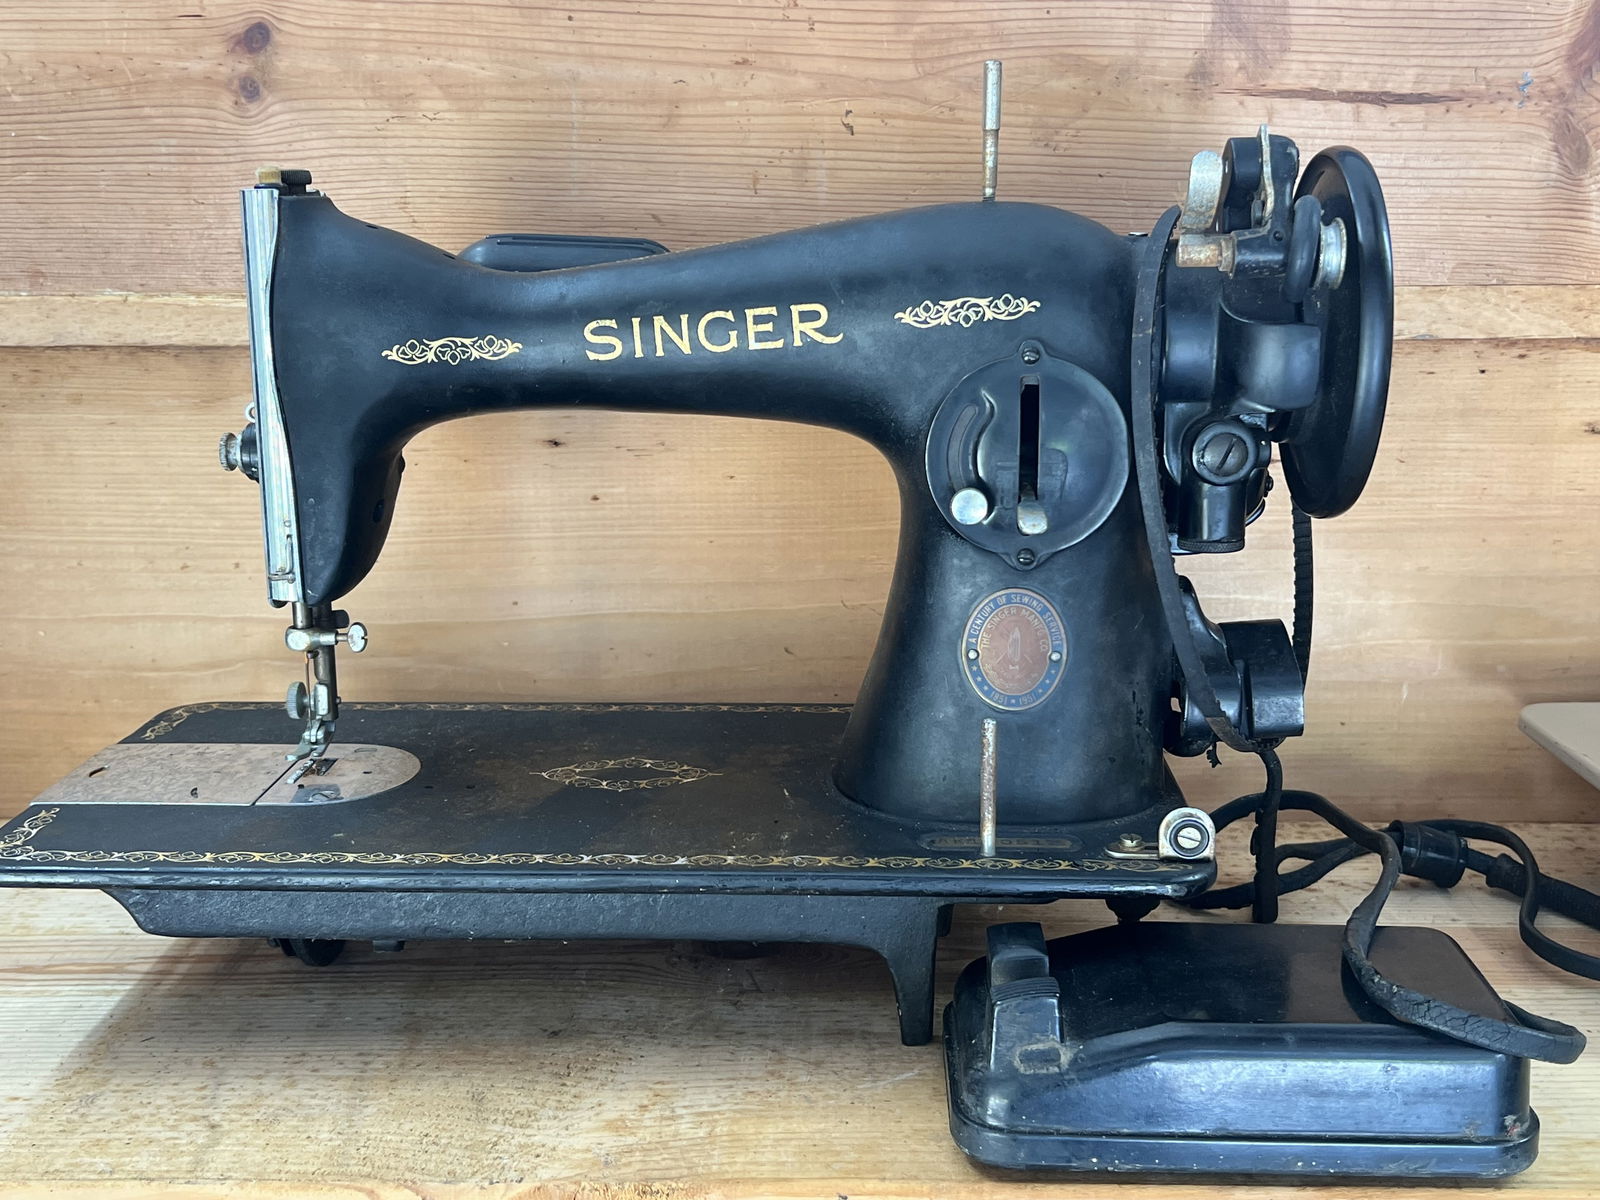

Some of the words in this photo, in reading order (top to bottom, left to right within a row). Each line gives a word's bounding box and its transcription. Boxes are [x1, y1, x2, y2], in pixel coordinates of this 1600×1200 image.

[583, 303, 844, 361] SINGER
[970, 604, 996, 635] CENTURY
[996, 597, 1007, 606] OF
[1010, 594, 1043, 611] SEWING
[1043, 612, 1062, 645] SERVICE
[981, 632, 992, 649] THE
[988, 608, 1017, 631] SINGER
